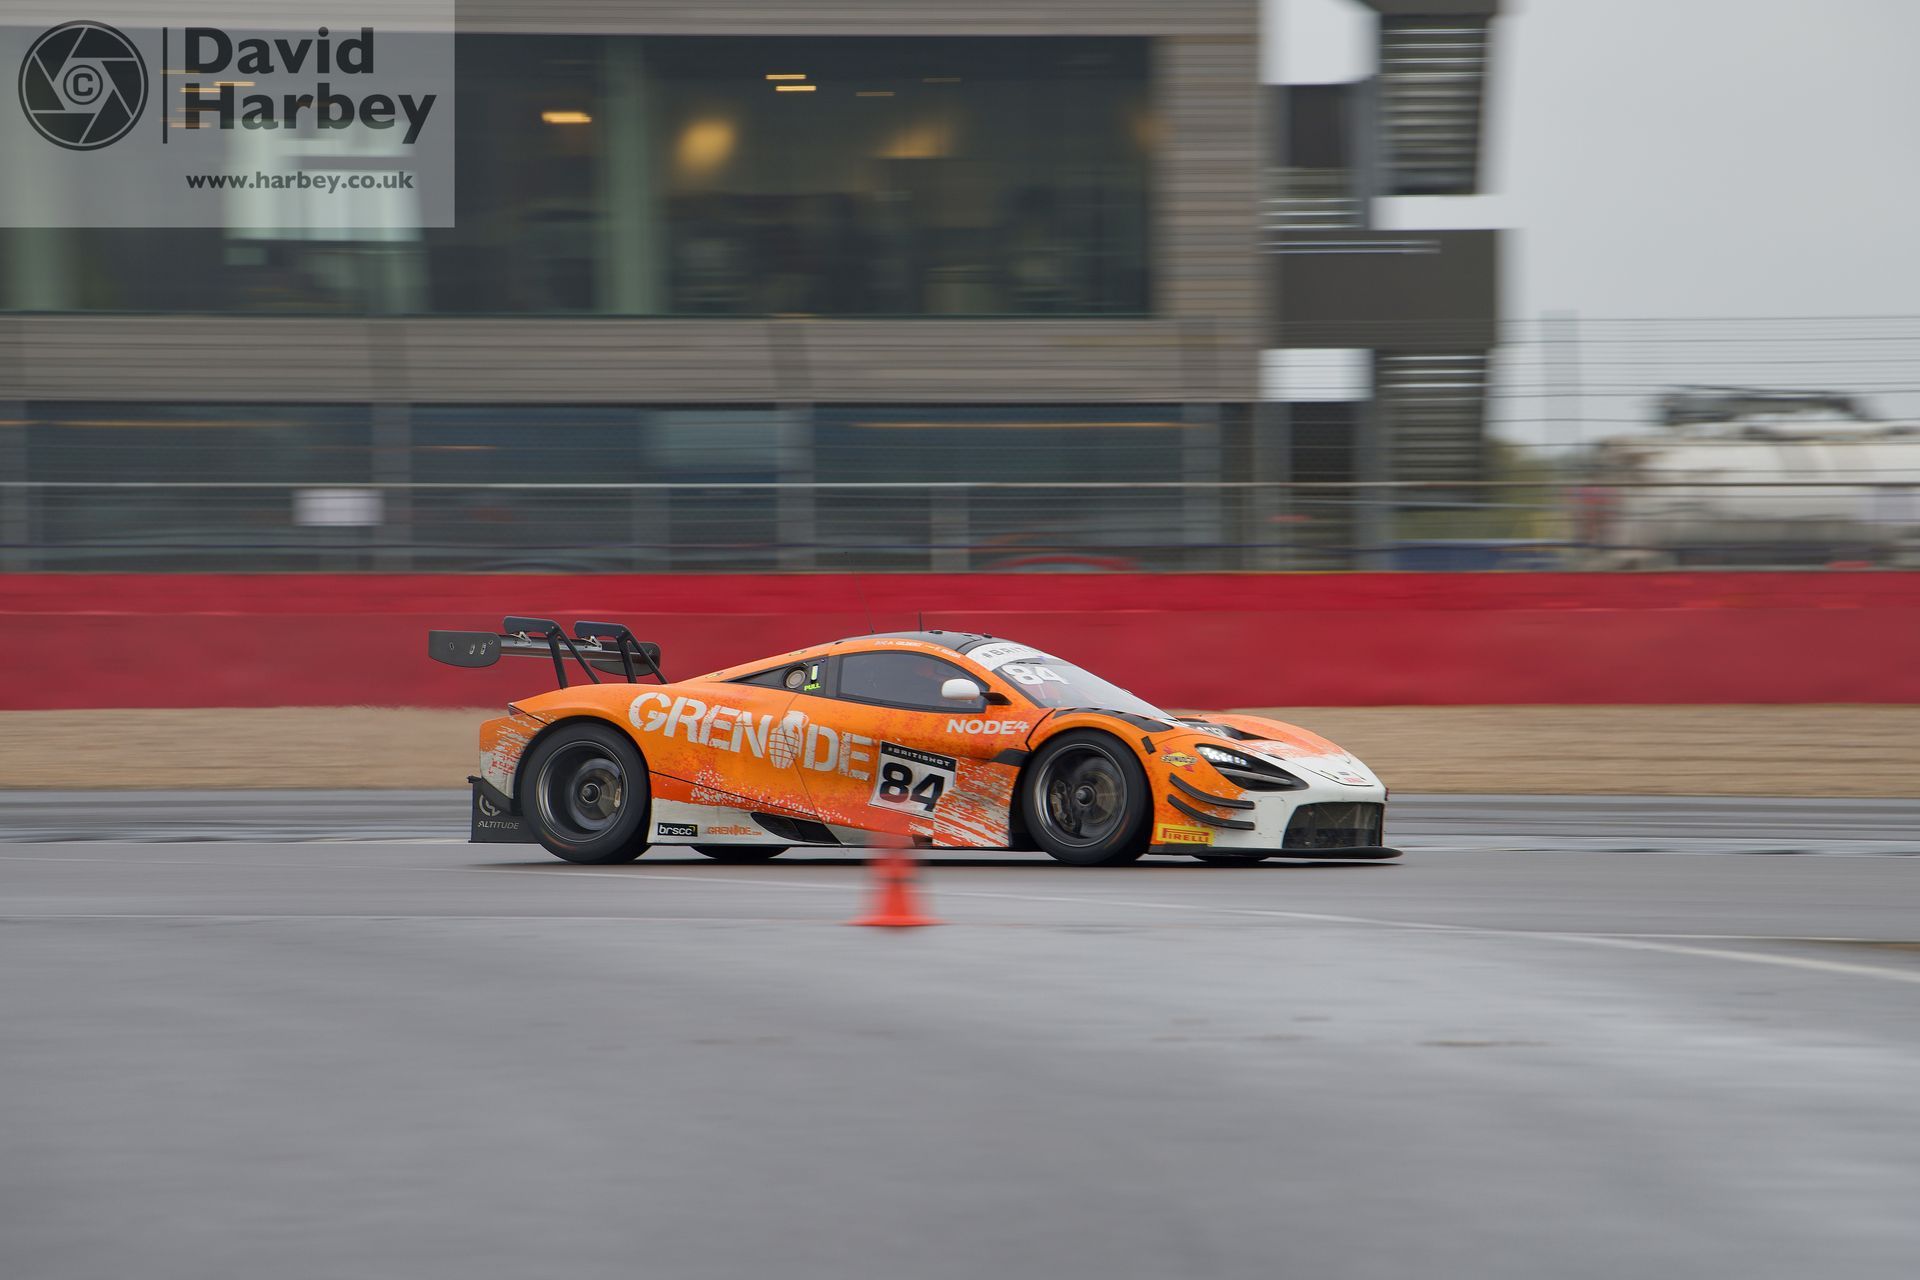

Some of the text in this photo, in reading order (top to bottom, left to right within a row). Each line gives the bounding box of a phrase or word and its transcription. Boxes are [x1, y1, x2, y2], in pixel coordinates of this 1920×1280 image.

[1001, 665, 1071, 684] 84
[946, 719, 1030, 735] NODE4
[879, 762, 945, 812] 84
[477, 820, 520, 830] ALTITUDE
[658, 824, 693, 836] brscc
[1162, 827, 1209, 843] PIRELLI
